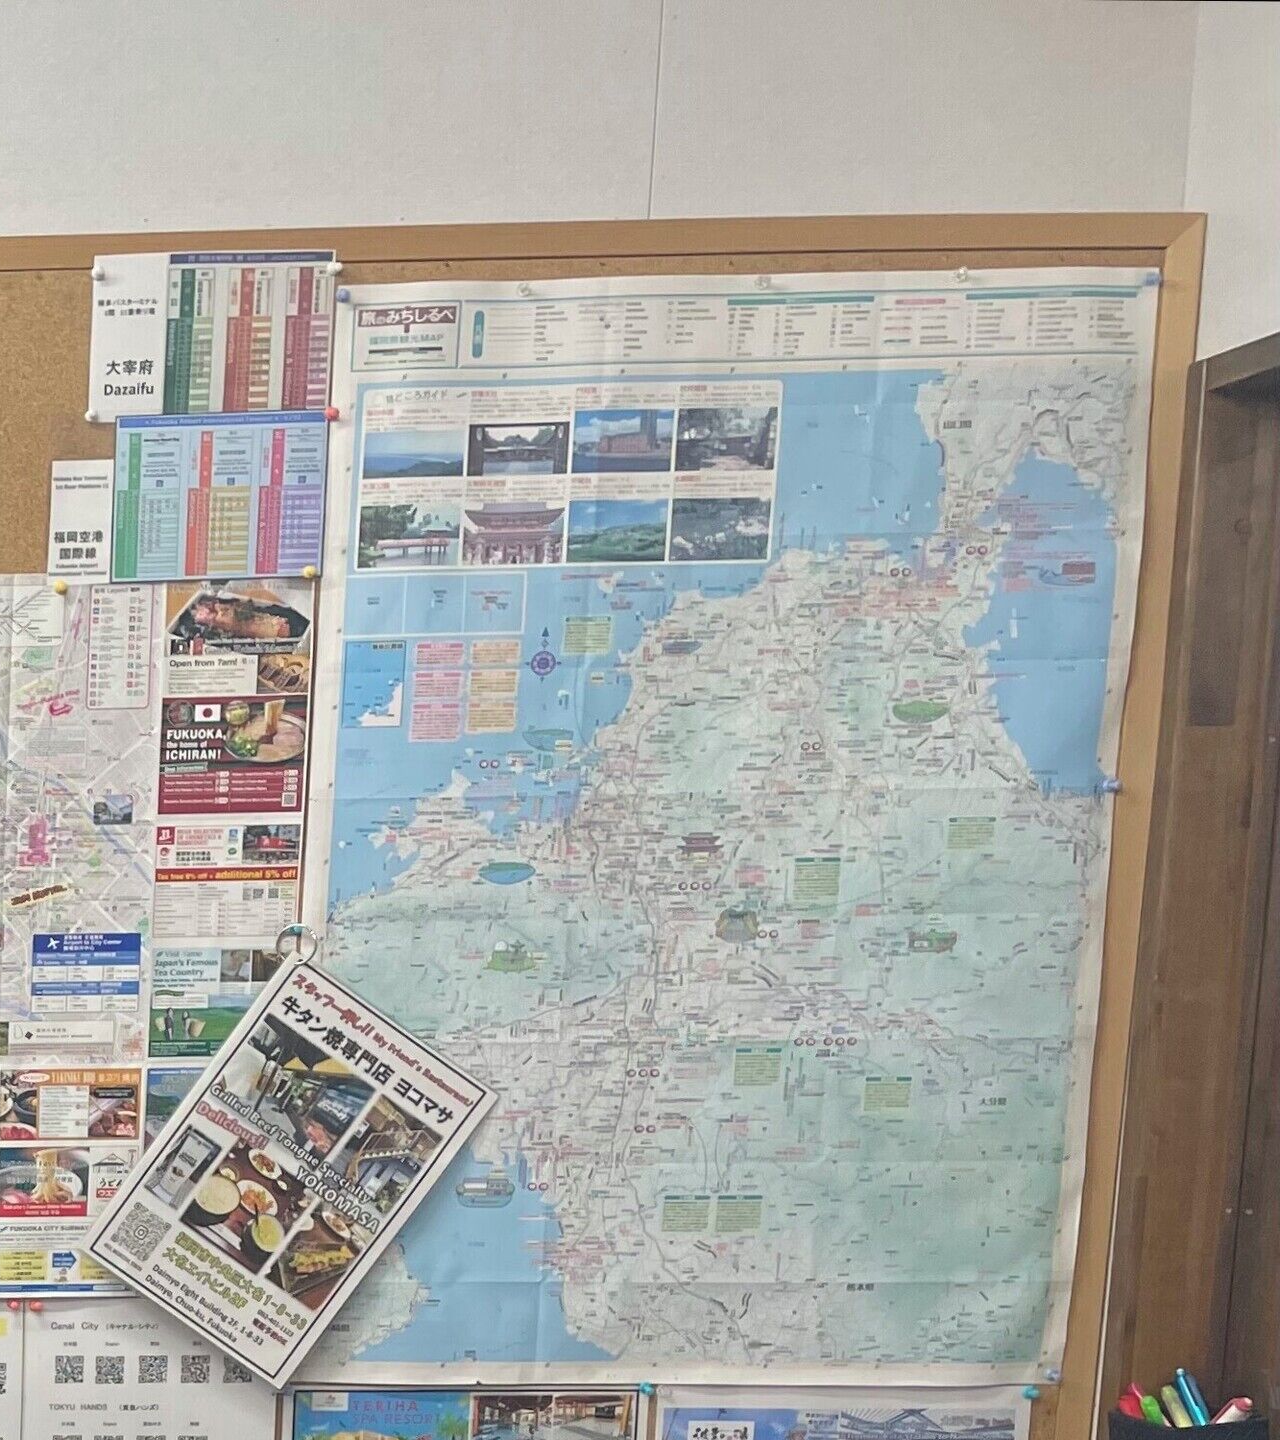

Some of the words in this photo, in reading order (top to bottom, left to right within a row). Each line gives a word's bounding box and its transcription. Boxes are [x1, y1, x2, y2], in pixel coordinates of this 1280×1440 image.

[106, 360, 154, 375] 大宰府
[104, 382, 154, 396] Dazaifu
[54, 531, 104, 544] 福岡空港
[170, 659, 191, 669] Open
[167, 729, 226, 740] FUKUOKA,
[166, 749, 221, 760] ICHIRAN!
[154, 959, 183, 967] Japan's
[154, 968, 167, 976] Tea
[170, 968, 203, 977] Country
[281, 996, 396, 1086] 牛タン焼専門店
[393, 1077, 454, 1124] ヨコマサ
[210, 1085, 251, 1118] Grilled
[248, 1110, 278, 1135] Beef
[276, 1129, 319, 1168] Tongue
[317, 1162, 374, 1204] Specialty
[196, 1102, 270, 1152] Delicious!!
[294, 1166, 380, 1236] YOKOMASA
[145, 1275, 173, 1299] Daimyo,
[175, 1295, 205, 1323] Chuo-ku,
[207, 1318, 238, 1343] Fukuoka
[51, 1322, 75, 1330] Canal
[81, 1322, 99, 1331] City
[352, 1401, 419, 1412] TERIHA
